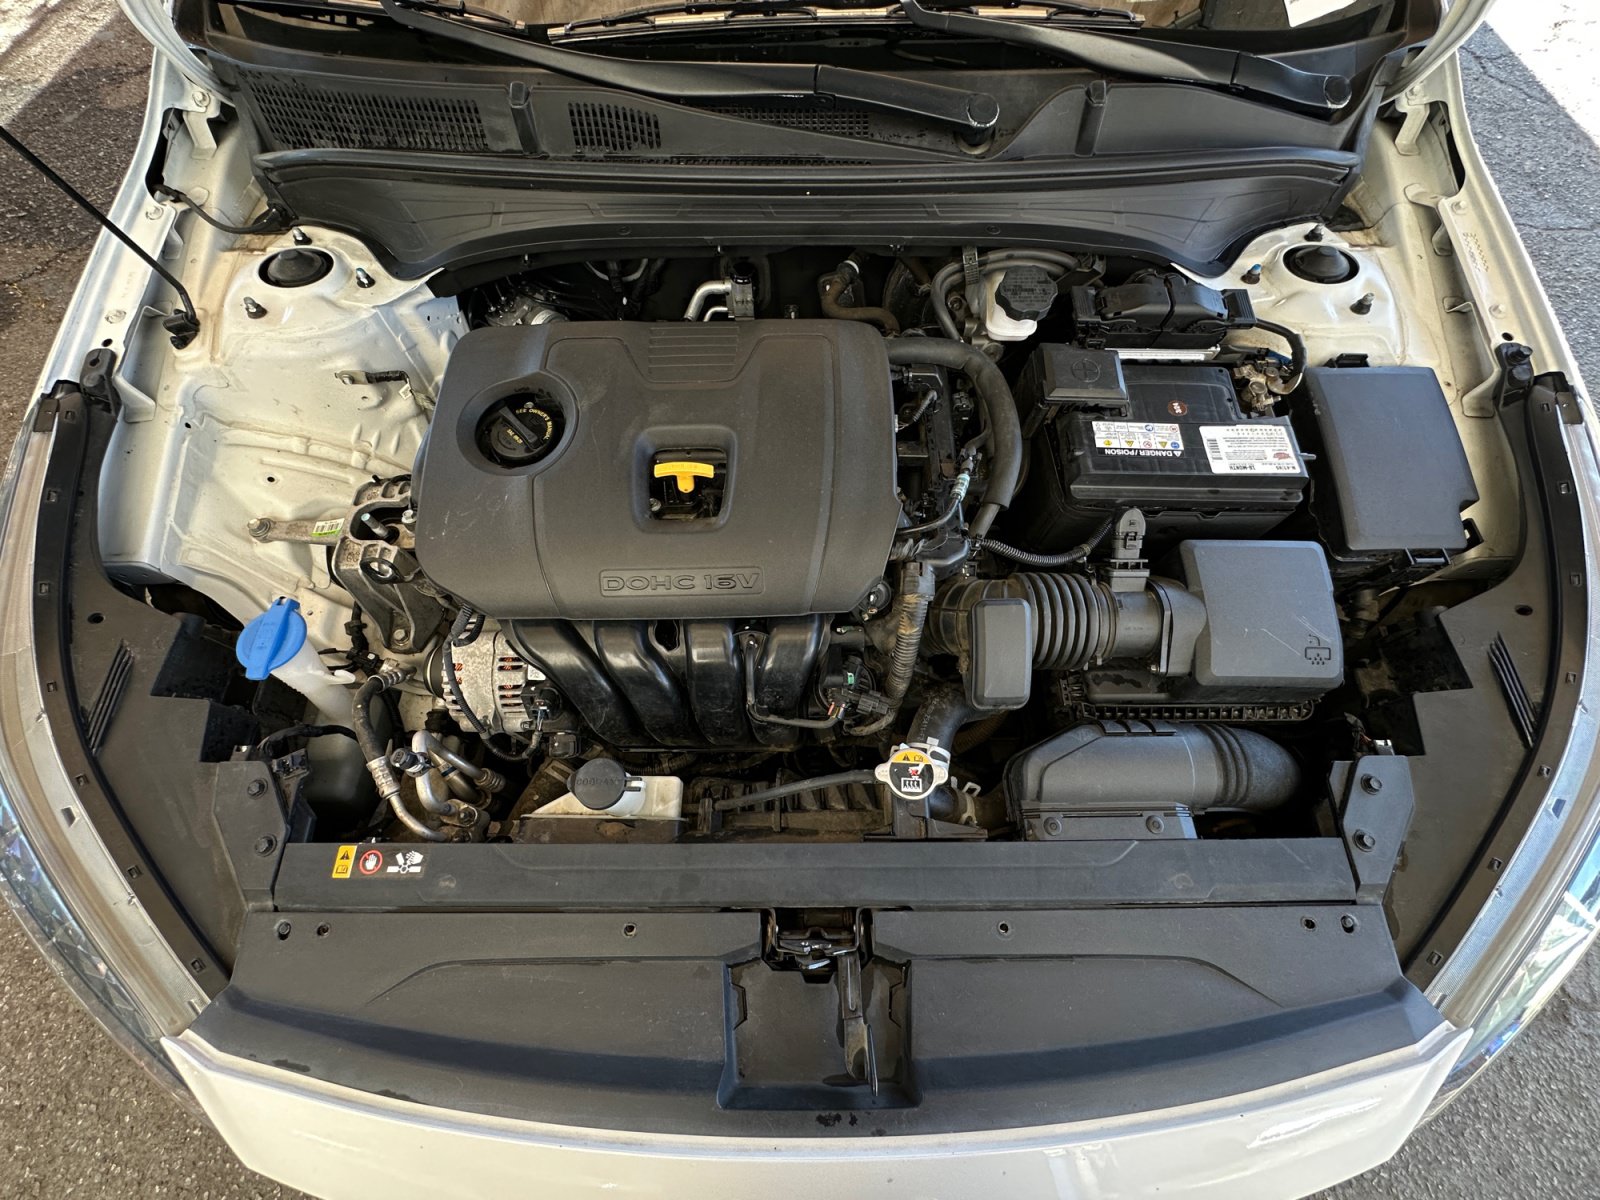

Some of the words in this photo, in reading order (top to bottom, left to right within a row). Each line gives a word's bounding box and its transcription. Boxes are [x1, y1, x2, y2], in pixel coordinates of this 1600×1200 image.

[1104, 448, 1132, 456] POISON
[602, 574, 696, 592] DOHC
[703, 573, 760, 590] 16V
